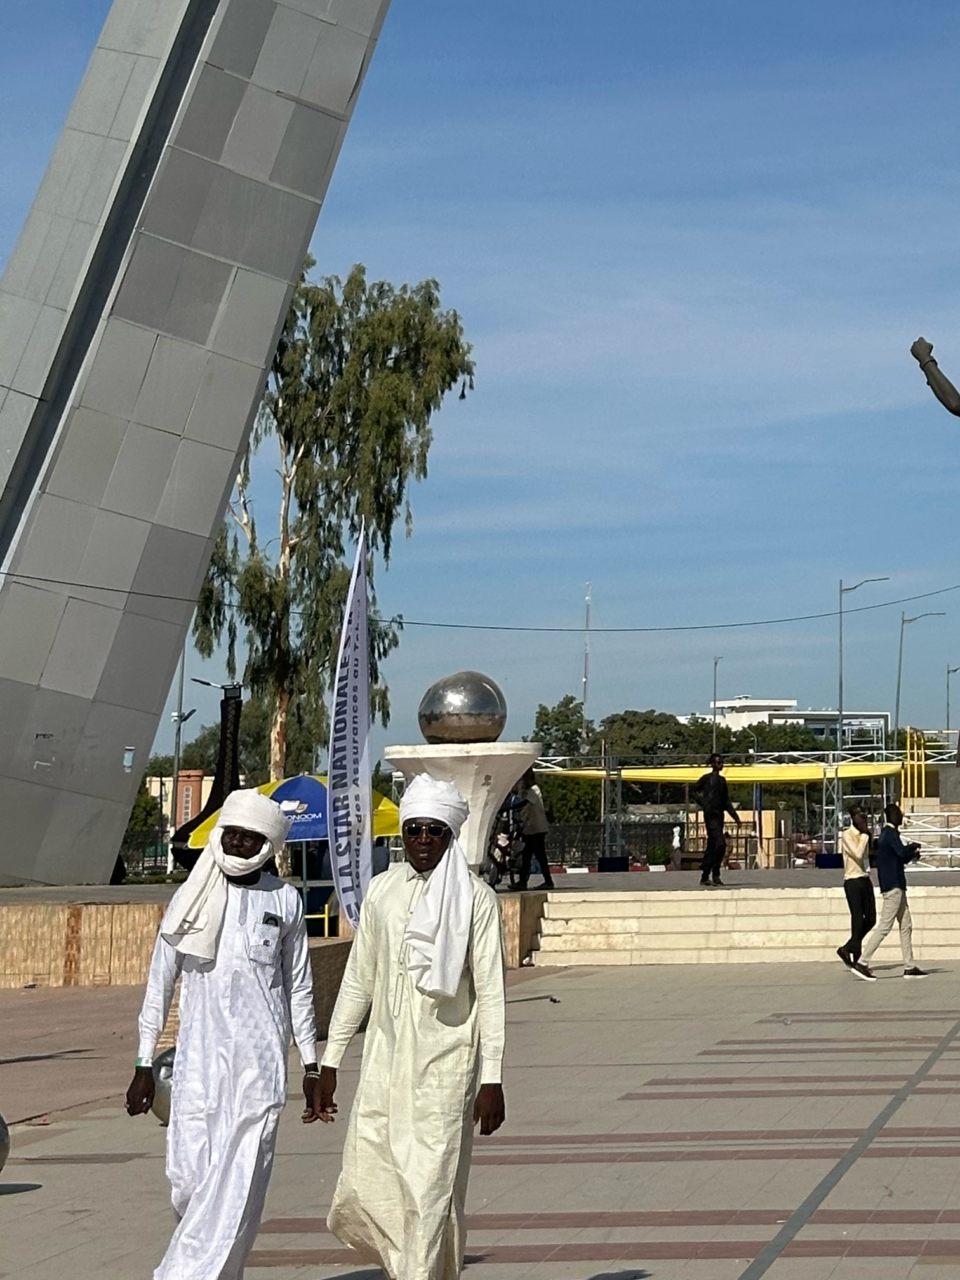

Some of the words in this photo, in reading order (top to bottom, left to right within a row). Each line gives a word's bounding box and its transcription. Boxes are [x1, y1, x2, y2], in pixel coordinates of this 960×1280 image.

[353, 658, 359, 679] au
[332, 655, 349, 790] NATIONALE
[352, 685, 360, 788] Assurances
[285, 813, 322, 821] ONOOM
[333, 794, 352, 858] STAR
[354, 794, 362, 824] des
[338, 860, 354, 894] LA
